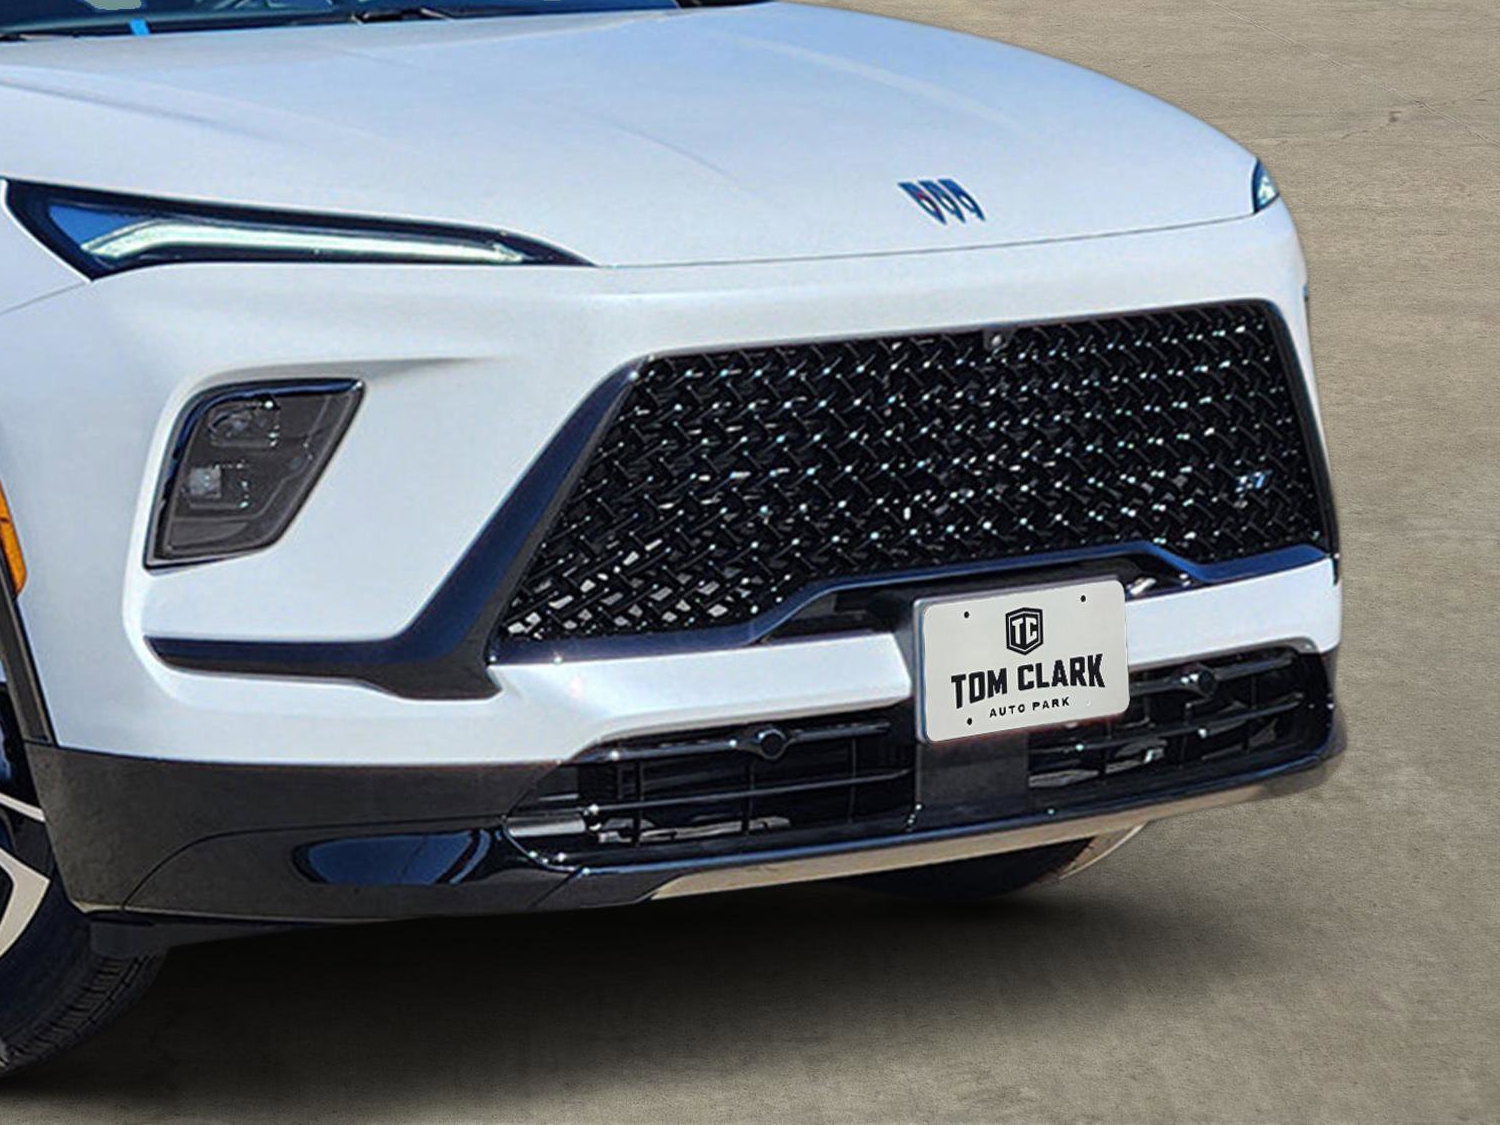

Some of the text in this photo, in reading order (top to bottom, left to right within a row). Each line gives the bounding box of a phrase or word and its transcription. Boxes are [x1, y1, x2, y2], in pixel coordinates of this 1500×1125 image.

[950, 652, 1106, 710] TOM CLARK
[989, 696, 1070, 719] AUTO PARK
